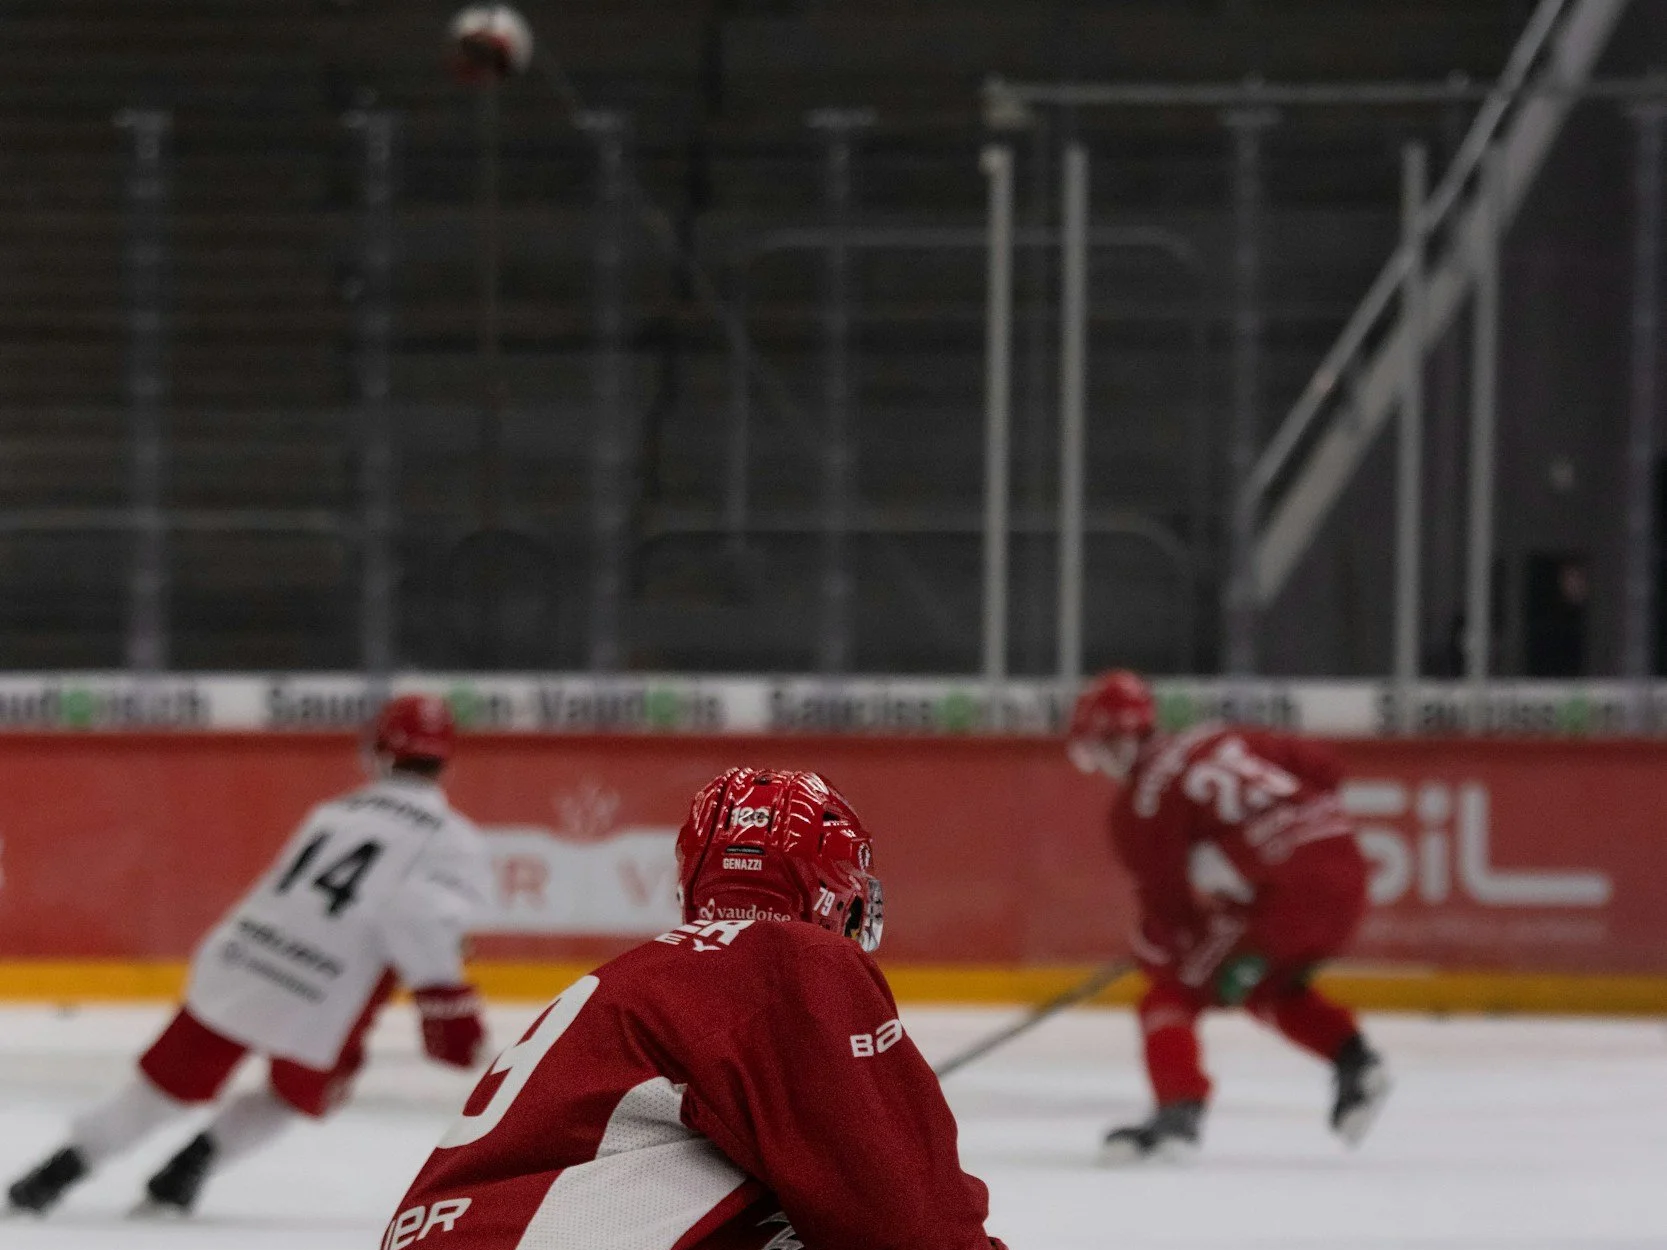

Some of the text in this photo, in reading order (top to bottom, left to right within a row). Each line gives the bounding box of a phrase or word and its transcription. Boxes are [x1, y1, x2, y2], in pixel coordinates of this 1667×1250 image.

[275, 828, 384, 918] 14
[722, 858, 763, 871] GENAZZI
[717, 904, 791, 922] vaudoise
[813, 886, 836, 917] 79
